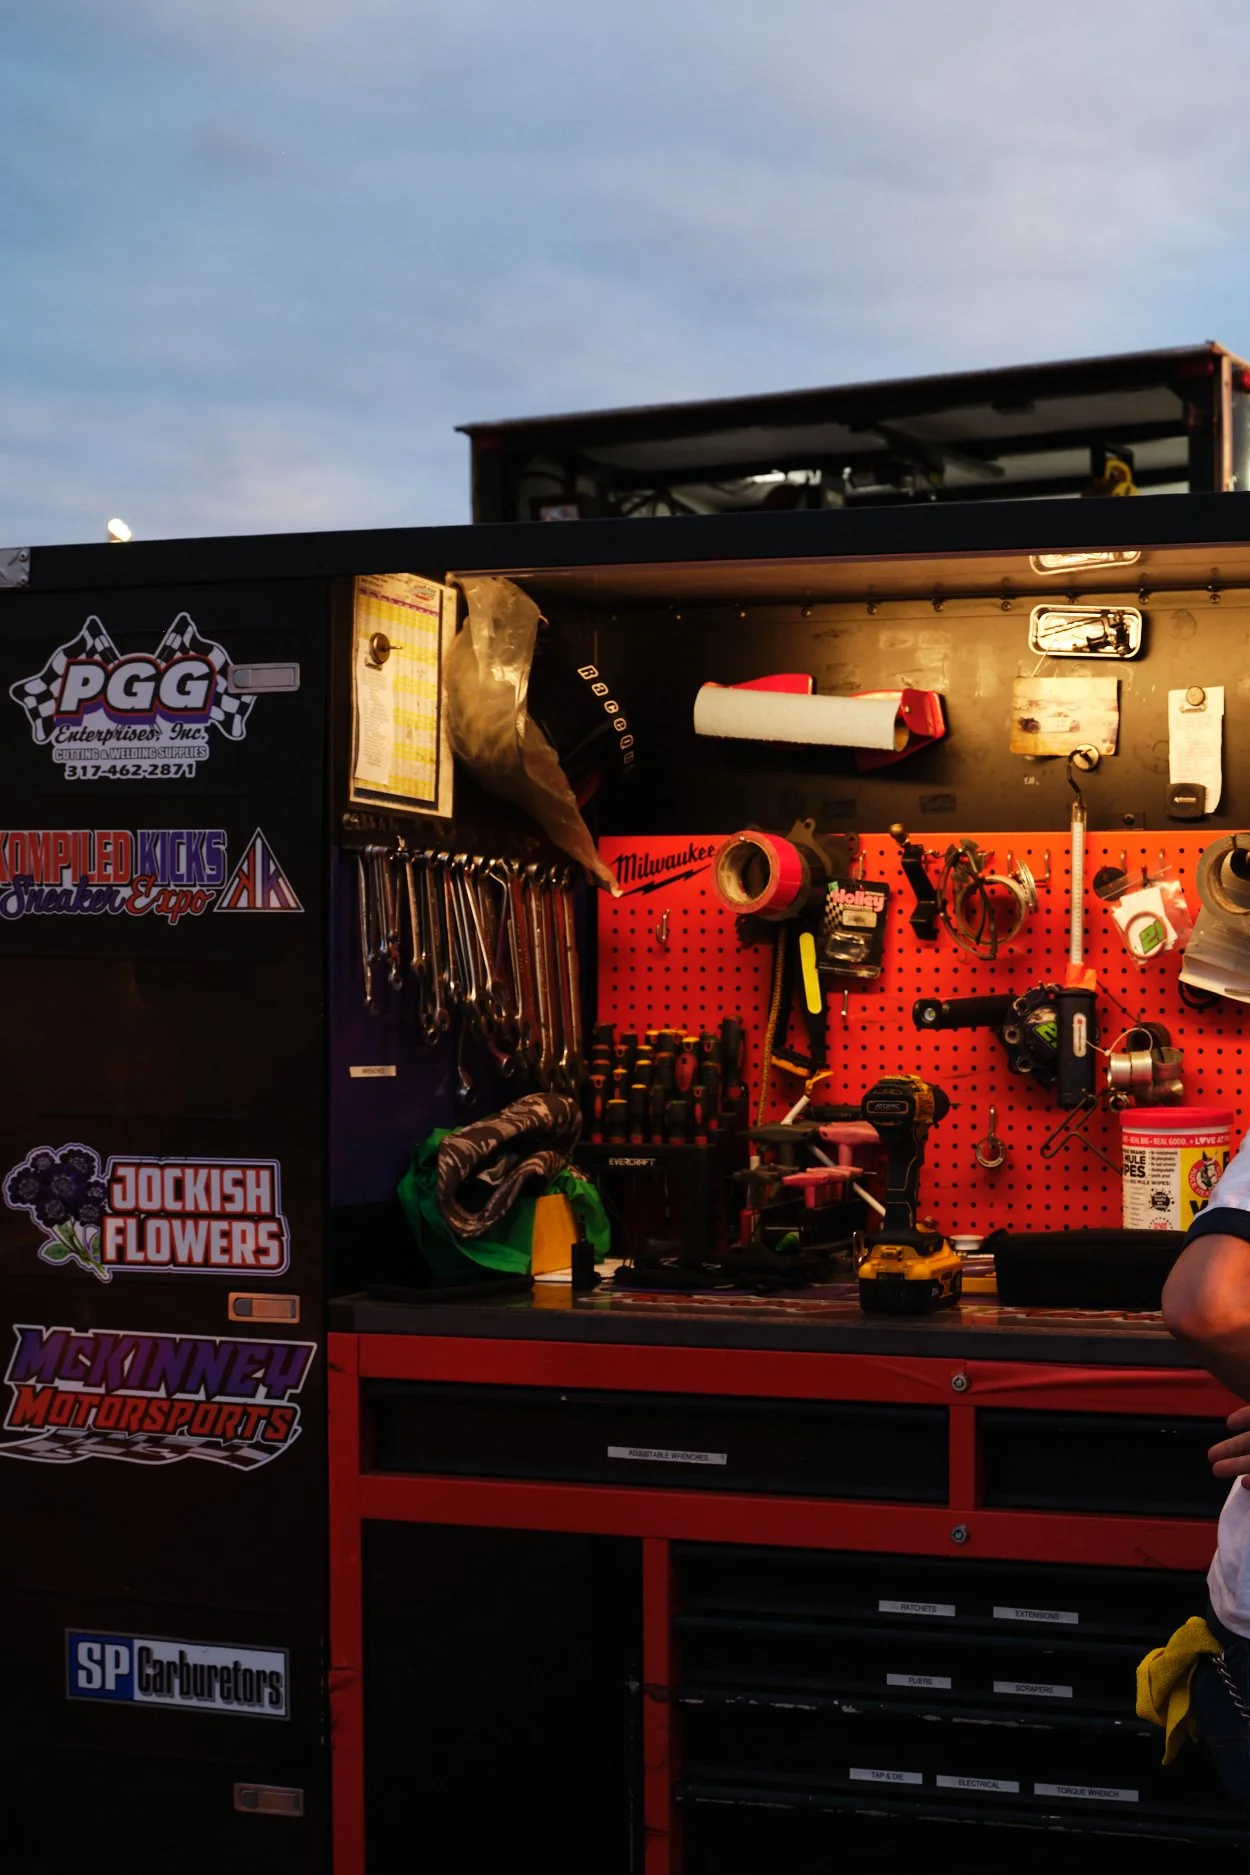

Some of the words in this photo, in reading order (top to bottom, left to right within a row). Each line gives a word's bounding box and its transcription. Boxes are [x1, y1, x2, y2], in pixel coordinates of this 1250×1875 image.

[56, 656, 214, 718] PGG
[169, 721, 207, 741] Inc.
[54, 748, 99, 762] CUTTING
[101, 748, 108, 761] &
[110, 747, 156, 761] WELDING
[158, 746, 207, 761] SUPPLIES
[66, 762, 195, 778] 317-462-2871
[138, 830, 225, 884] KICKS
[610, 843, 716, 886] Milwaukee
[2, 875, 126, 918] Sneaker
[125, 873, 214, 925] Expo
[831, 888, 885, 913] Holley
[608, 1157, 657, 1167] EVERCRAFT
[110, 1166, 274, 1214] JOCKISH
[104, 1217, 281, 1266] FLOWERS
[9, 1384, 297, 1444] MOTORSPORTS
[900, 1603, 937, 1613] RATCHETS
[1015, 1610, 1060, 1621] EXTENSIONS
[77, 1641, 130, 1690] SP
[137, 1646, 285, 1710] Carburetors
[908, 1676, 933, 1686] PLIERS
[1015, 1684, 1054, 1694] SCRAPERS
[871, 1771, 885, 1780] TAP
[958, 1779, 1001, 1790] ELECTRICAL
[1056, 1787, 1087, 1797] TORQUE
[1088, 1789, 1119, 1798] WRENCH
